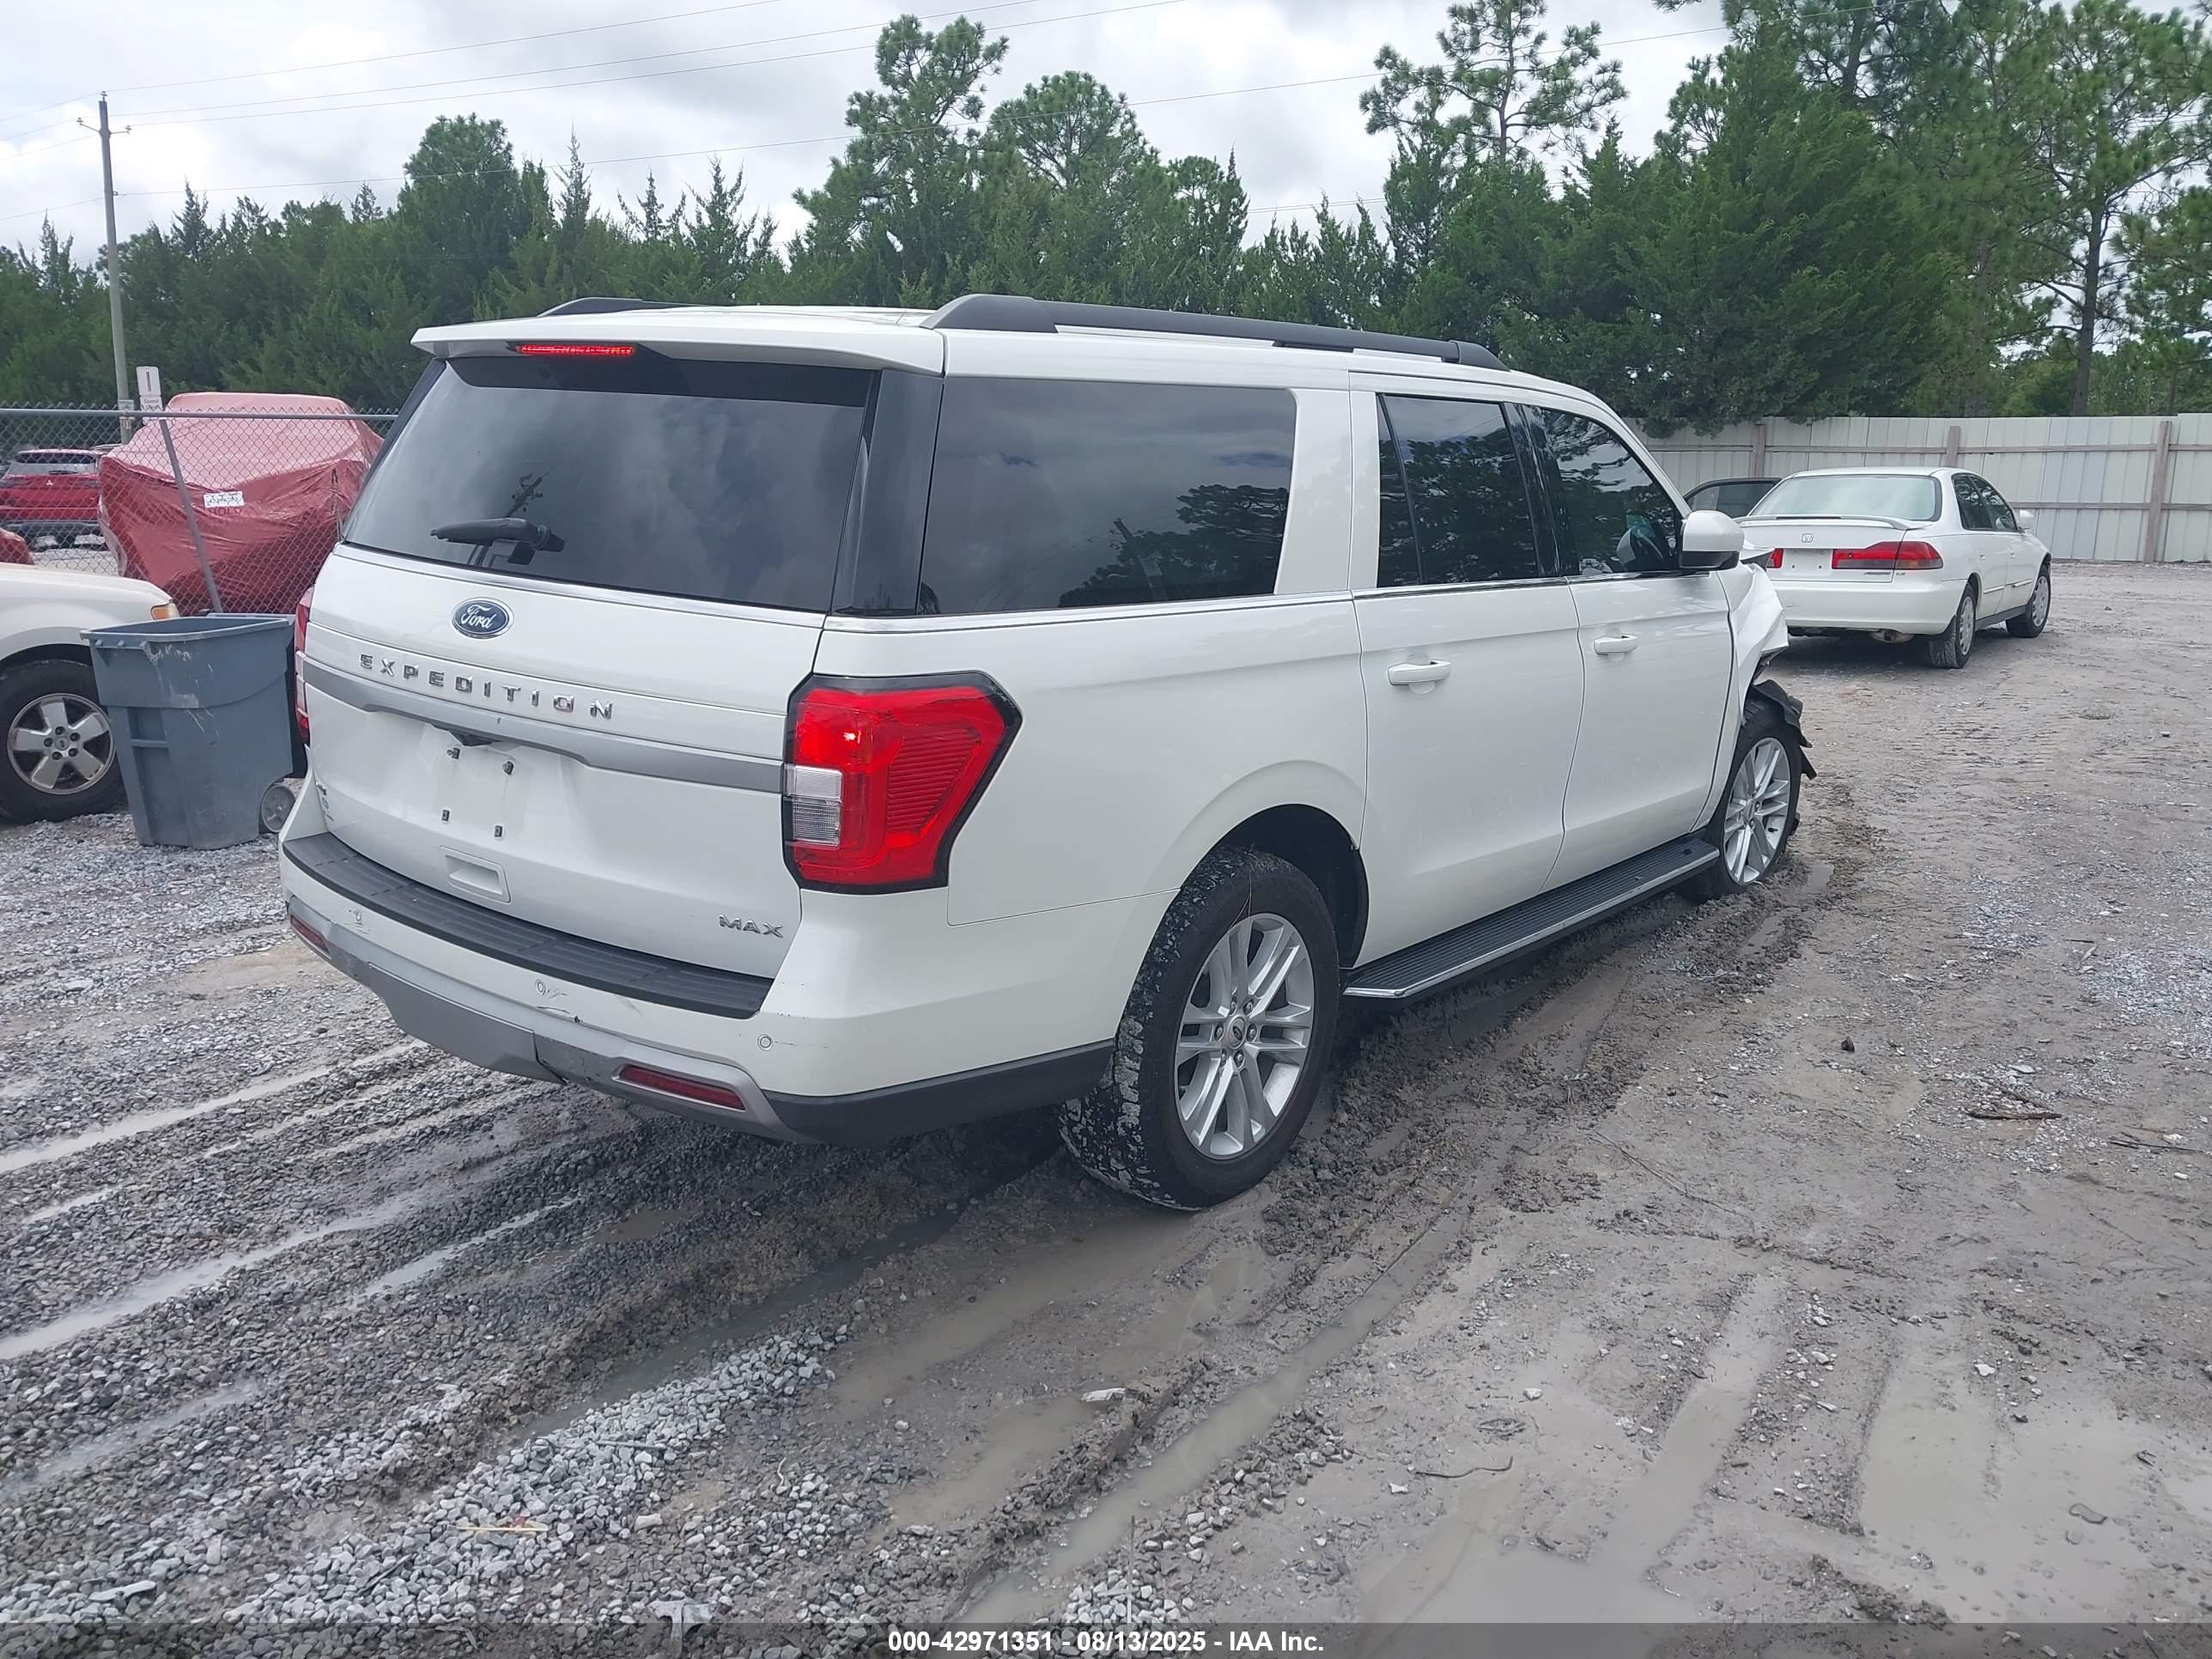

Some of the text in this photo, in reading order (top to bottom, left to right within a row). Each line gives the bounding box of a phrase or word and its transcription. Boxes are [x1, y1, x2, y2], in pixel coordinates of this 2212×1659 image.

[460, 605, 497, 629] Ford
[360, 653, 613, 720] EXPEDITION
[720, 915, 783, 939] MAX
